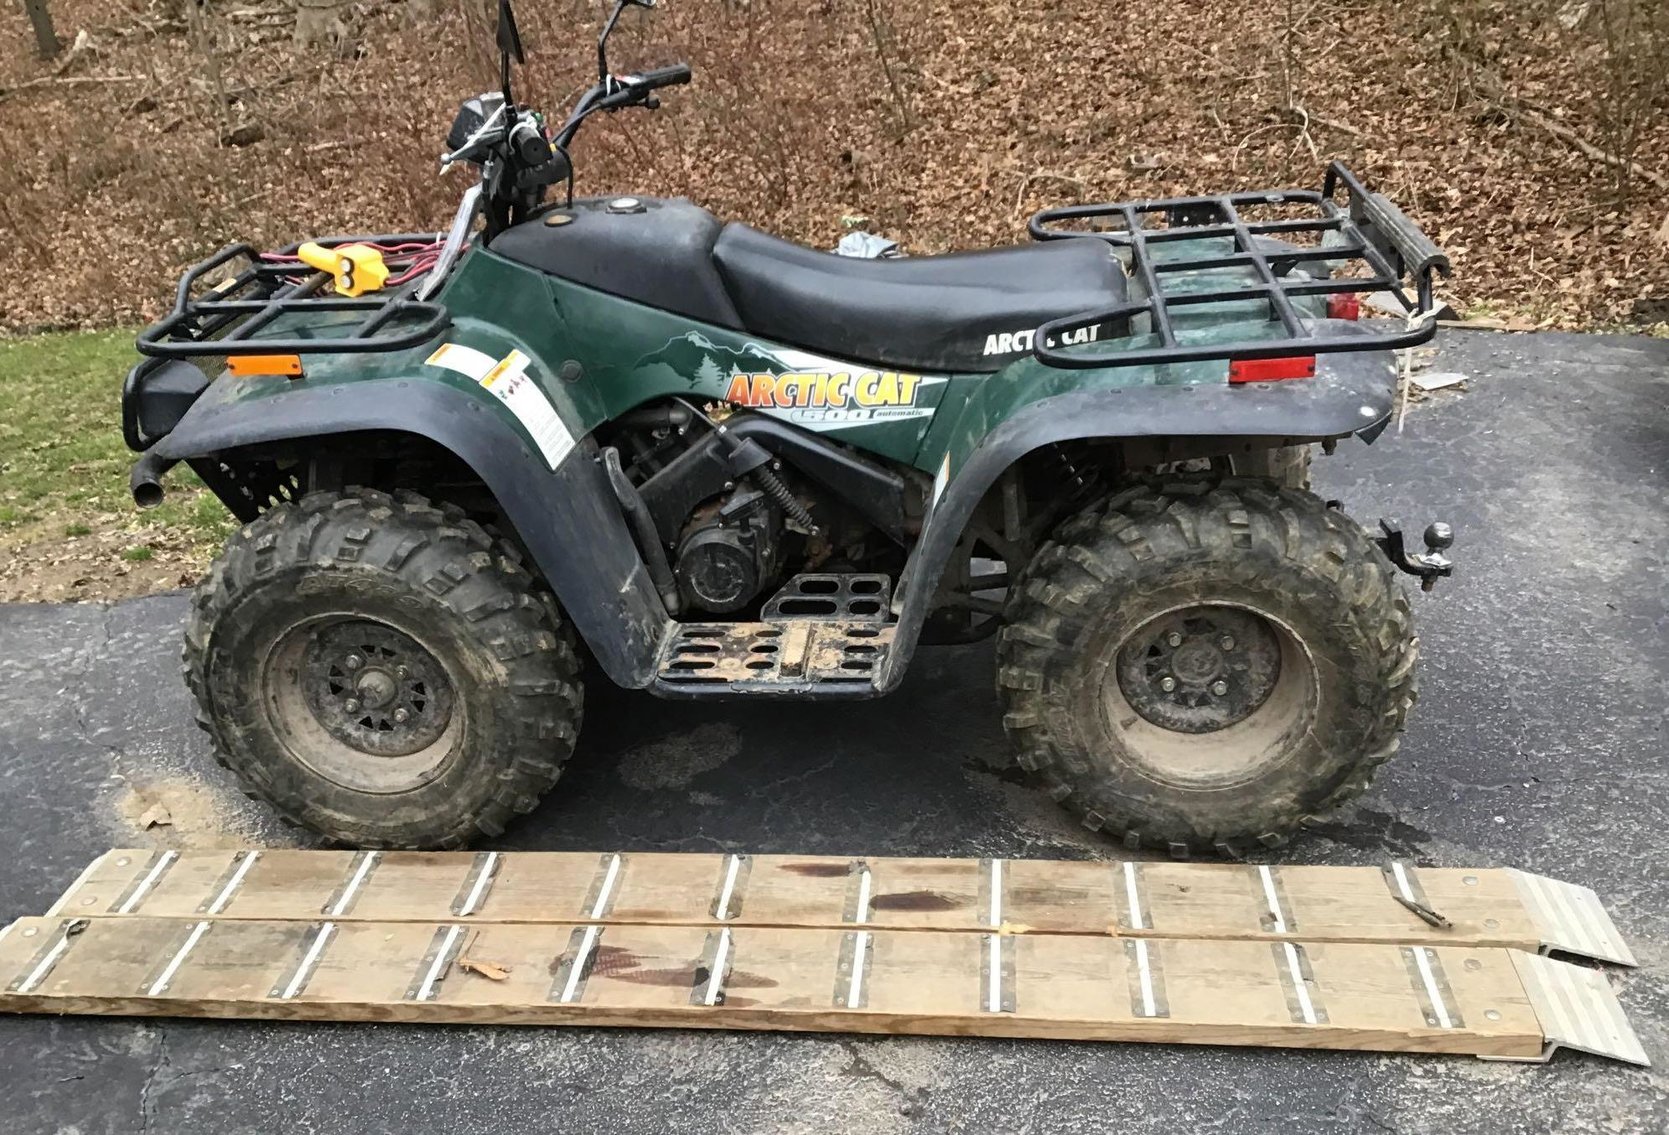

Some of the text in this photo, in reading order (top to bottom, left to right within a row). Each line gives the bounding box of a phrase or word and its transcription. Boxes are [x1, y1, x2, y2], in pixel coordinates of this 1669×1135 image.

[1061, 324, 1101, 345] CAT
[727, 372, 922, 408] ARCTIC CAT
